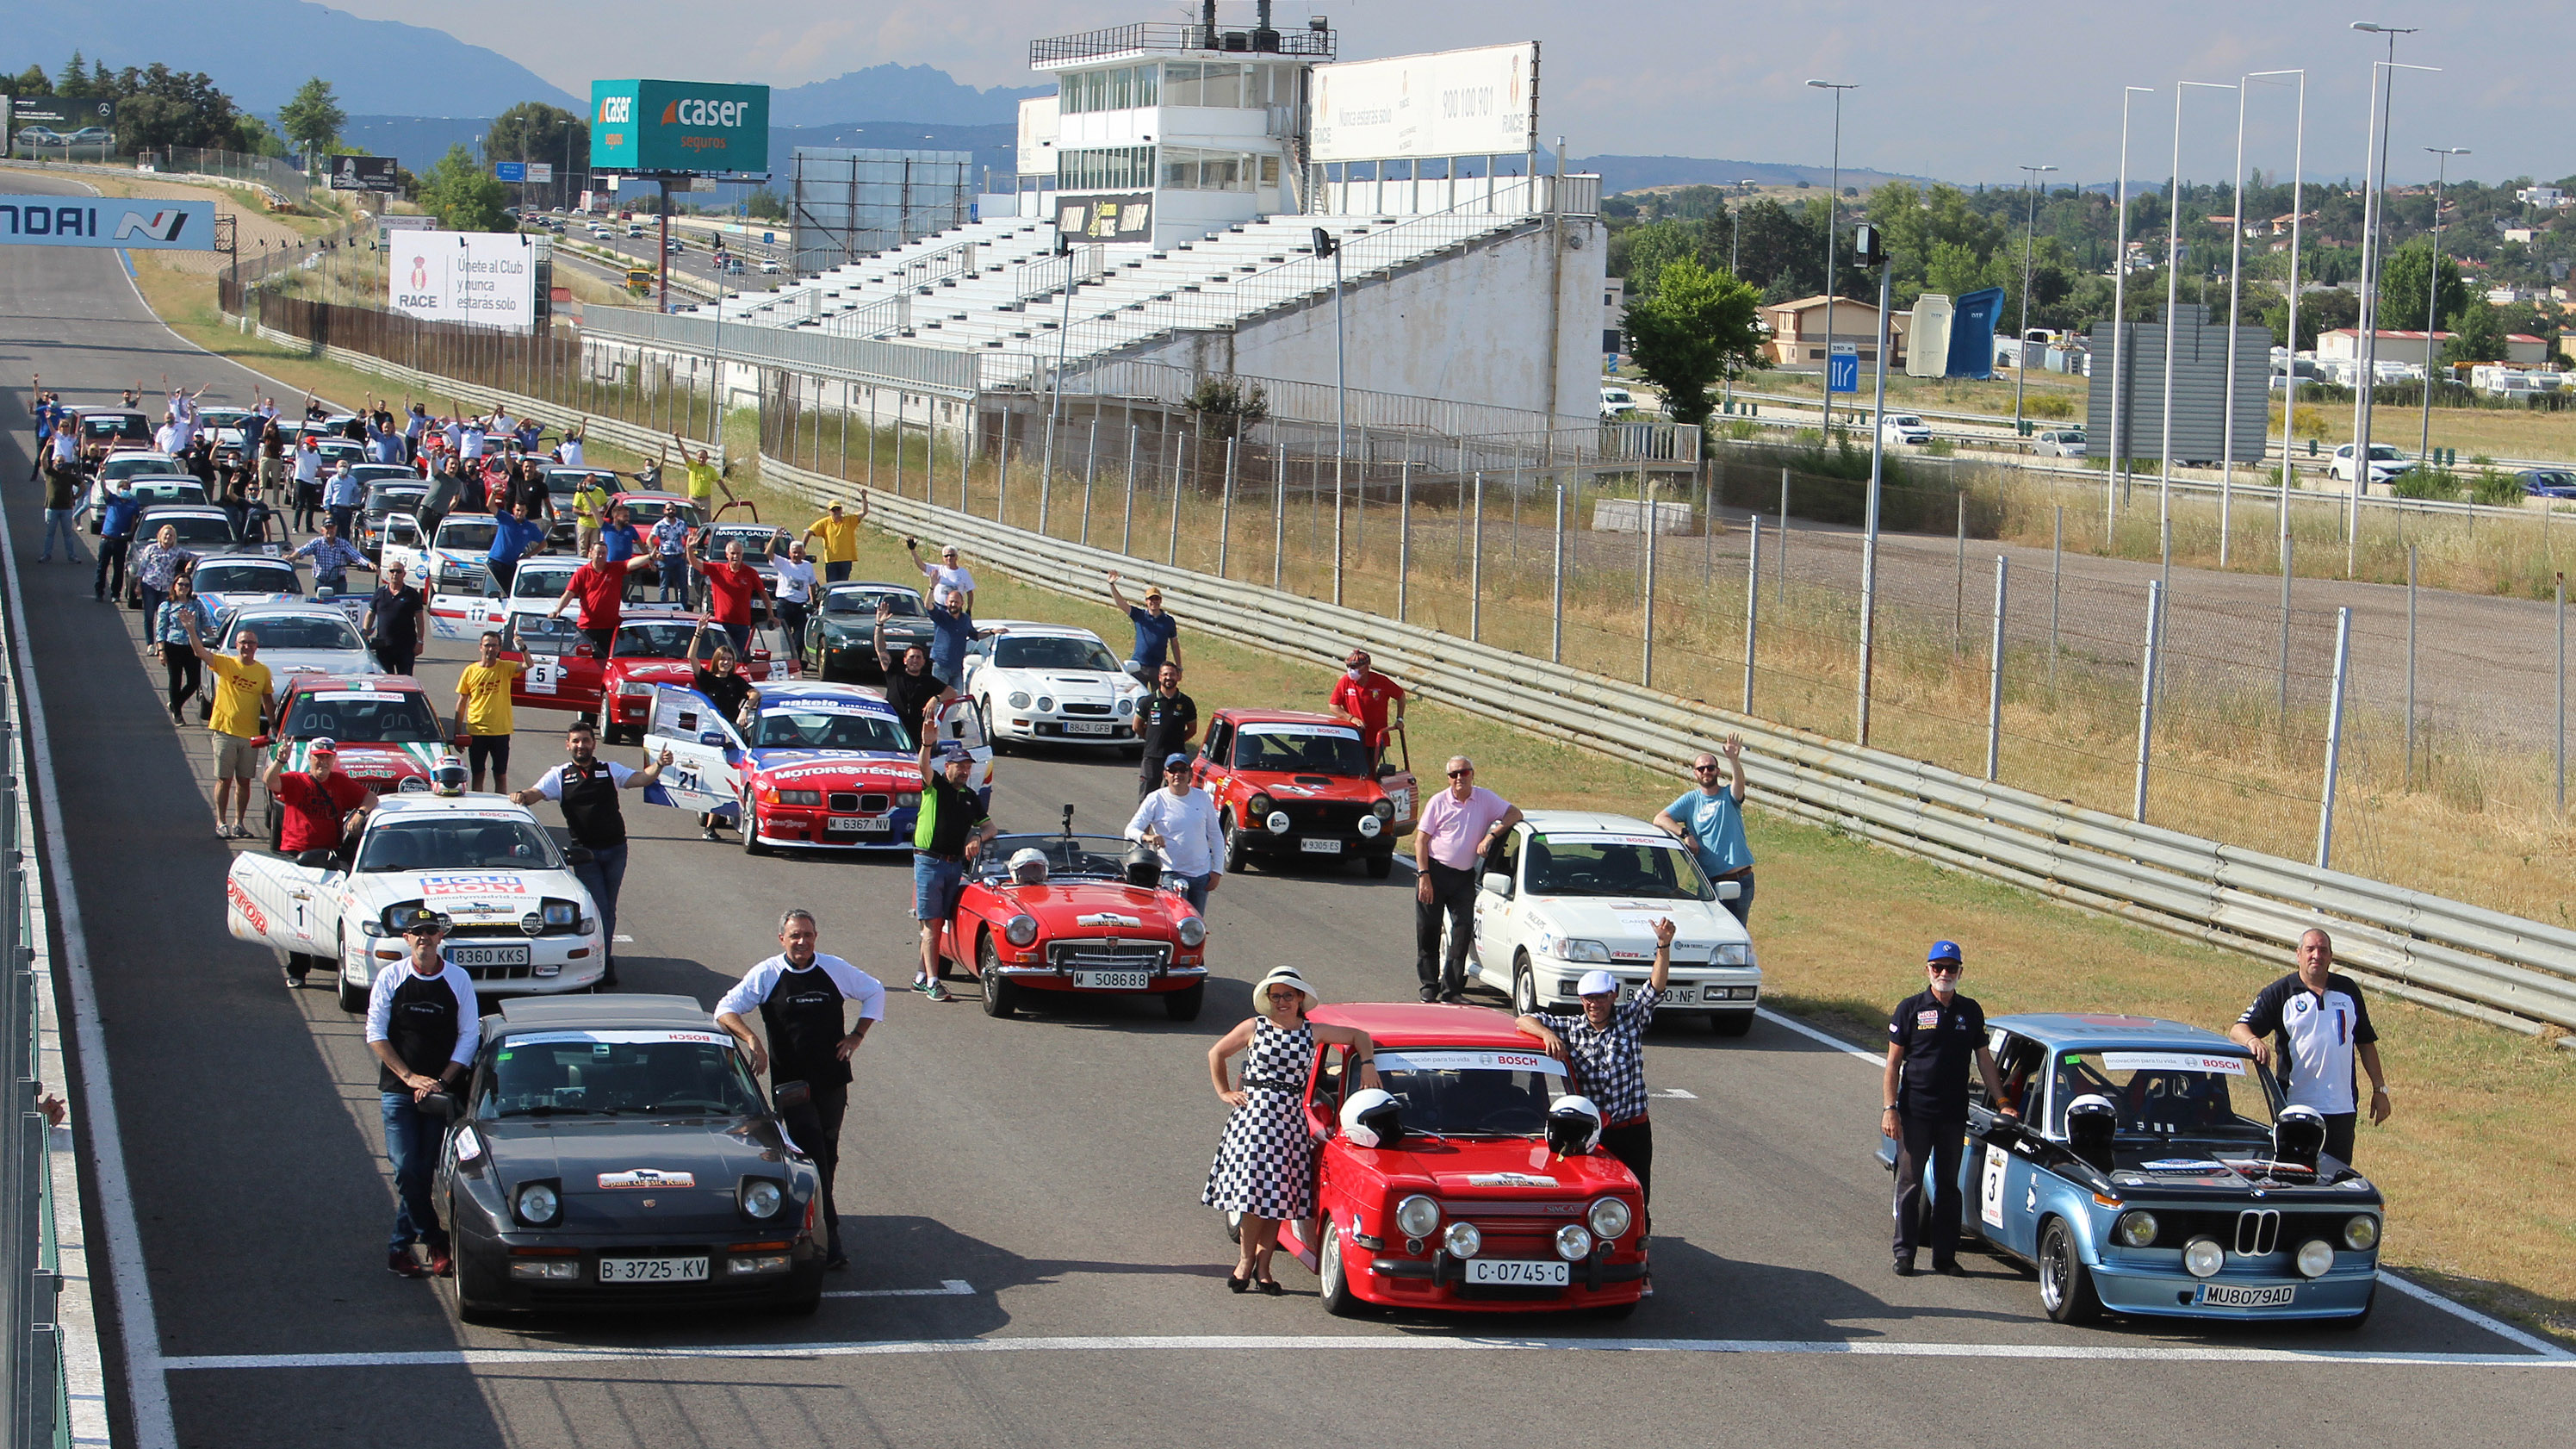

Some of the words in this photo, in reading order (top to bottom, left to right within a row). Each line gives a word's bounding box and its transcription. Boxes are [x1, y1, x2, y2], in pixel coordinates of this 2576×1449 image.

[605, 96, 631, 123] caser
[1443, 89, 1458, 119] 900
[1461, 87, 1476, 117] 100
[1478, 85, 1493, 116] 901
[678, 98, 748, 127] caser
[1338, 106, 1356, 127] Nunca
[1379, 103, 1392, 125] solo
[1502, 113, 1524, 134] RACE
[605, 134, 623, 149] seguros
[1313, 127, 1331, 145] RACE
[680, 135, 727, 153] seguros
[456, 253, 487, 273] Únete
[488, 258, 498, 273] al
[500, 259, 523, 274] Club
[457, 279, 465, 294] y
[465, 280, 494, 291] nunca
[399, 294, 438, 308] RACE
[456, 294, 493, 309] estarás
[496, 296, 516, 310] solo
[471, 609, 485, 621] 17
[537, 668, 546, 681] 5
[1095, 724, 1110, 732] GFB
[679, 771, 698, 790] 21
[776, 766, 839, 780] MOTOR
[860, 766, 924, 780] TÉCNIC
[1397, 795, 1403, 812] 2
[1301, 841, 1307, 849] M
[1309, 841, 1328, 850] 9305
[1330, 842, 1340, 851] ES
[424, 876, 519, 885] LIQUI
[425, 884, 523, 893] MOLY
[295, 904, 303, 927] 1
[522, 917, 543, 926] HELLA
[456, 950, 493, 964] 8360
[498, 949, 525, 963] KKS
[1077, 973, 1083, 986] M
[1095, 973, 1146, 986] 508688
[669, 1034, 710, 1042] BOSCH
[1432, 1056, 1448, 1065] para
[1498, 1055, 1538, 1066] BOSCH
[2202, 1059, 2241, 1070] BOSCH
[605, 1178, 631, 1188] Spain
[633, 1178, 663, 1187] Classic
[667, 1178, 694, 1189] Rally
[1989, 1172, 1997, 1201] 3
[1989, 1208, 1999, 1218] BOSCH
[2207, 1286, 2293, 1305] MU8079AD
